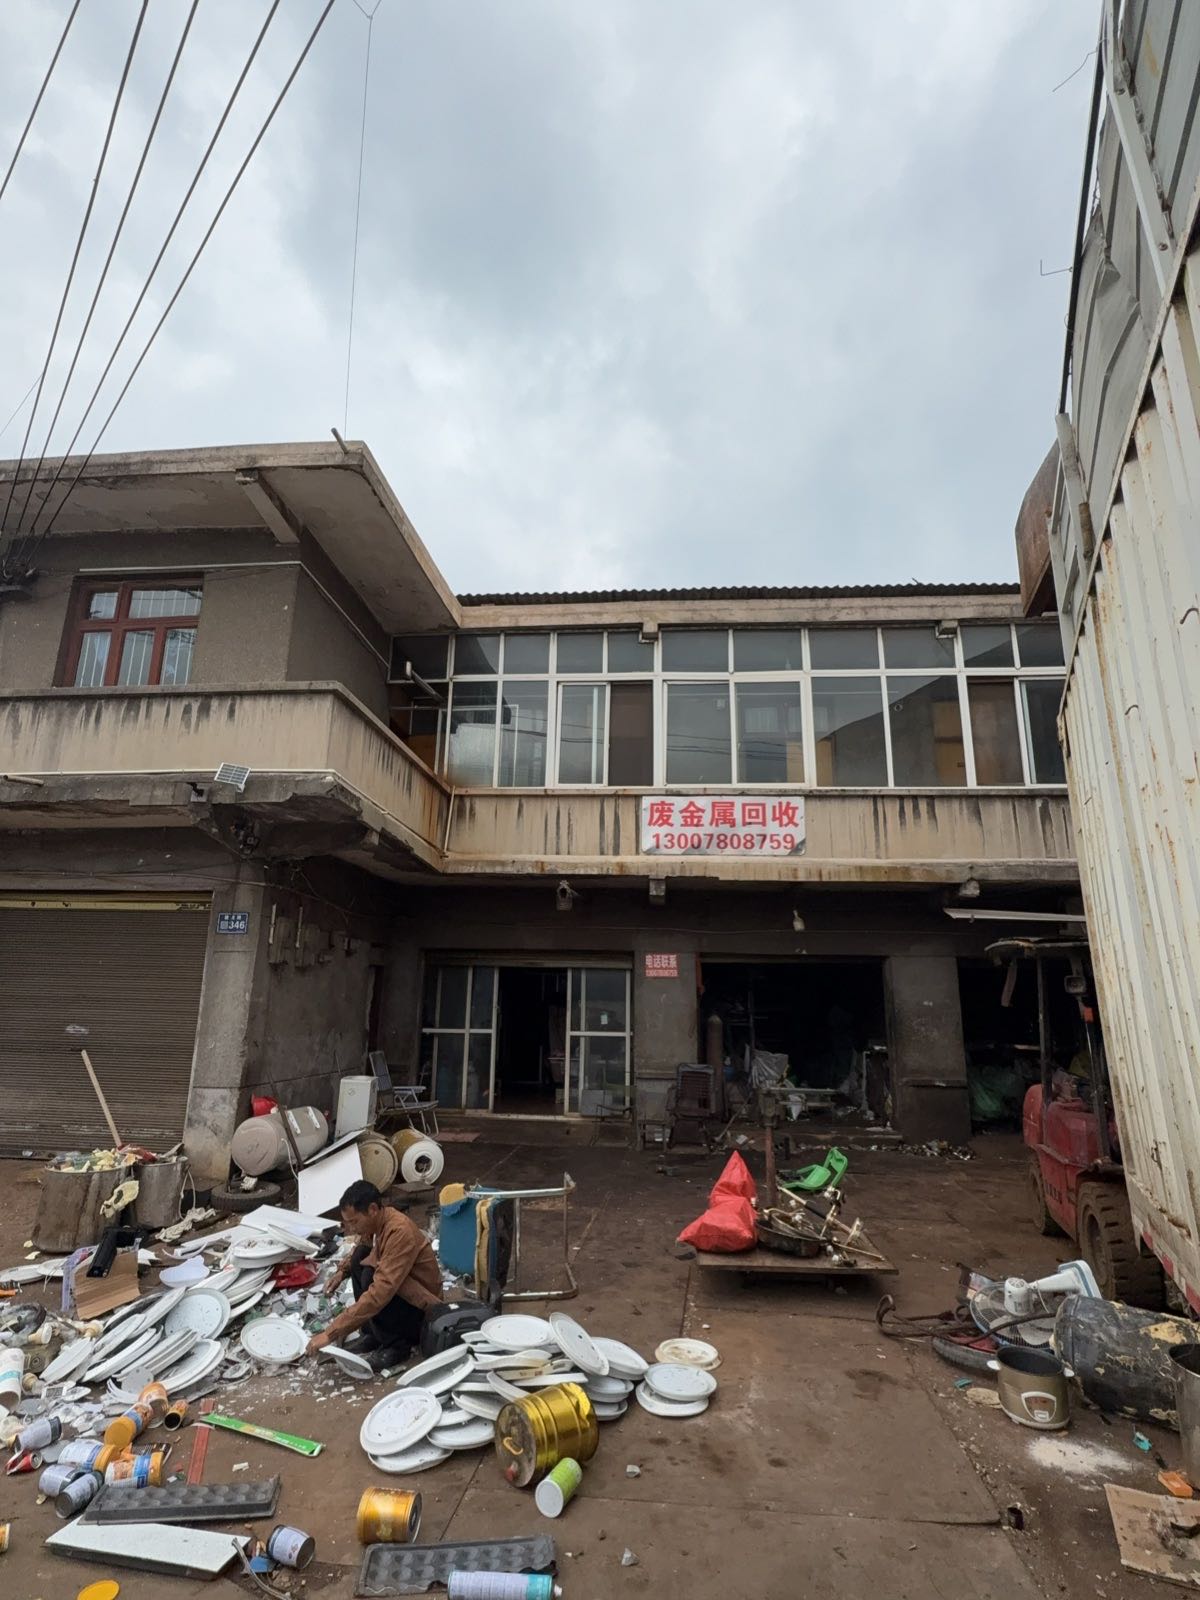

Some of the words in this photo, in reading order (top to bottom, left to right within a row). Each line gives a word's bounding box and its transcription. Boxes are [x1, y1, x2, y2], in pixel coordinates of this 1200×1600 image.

[647, 800, 800, 828] 废金属回收
[652, 833, 795, 850] 13007808759
[229, 920, 245, 929] 346
